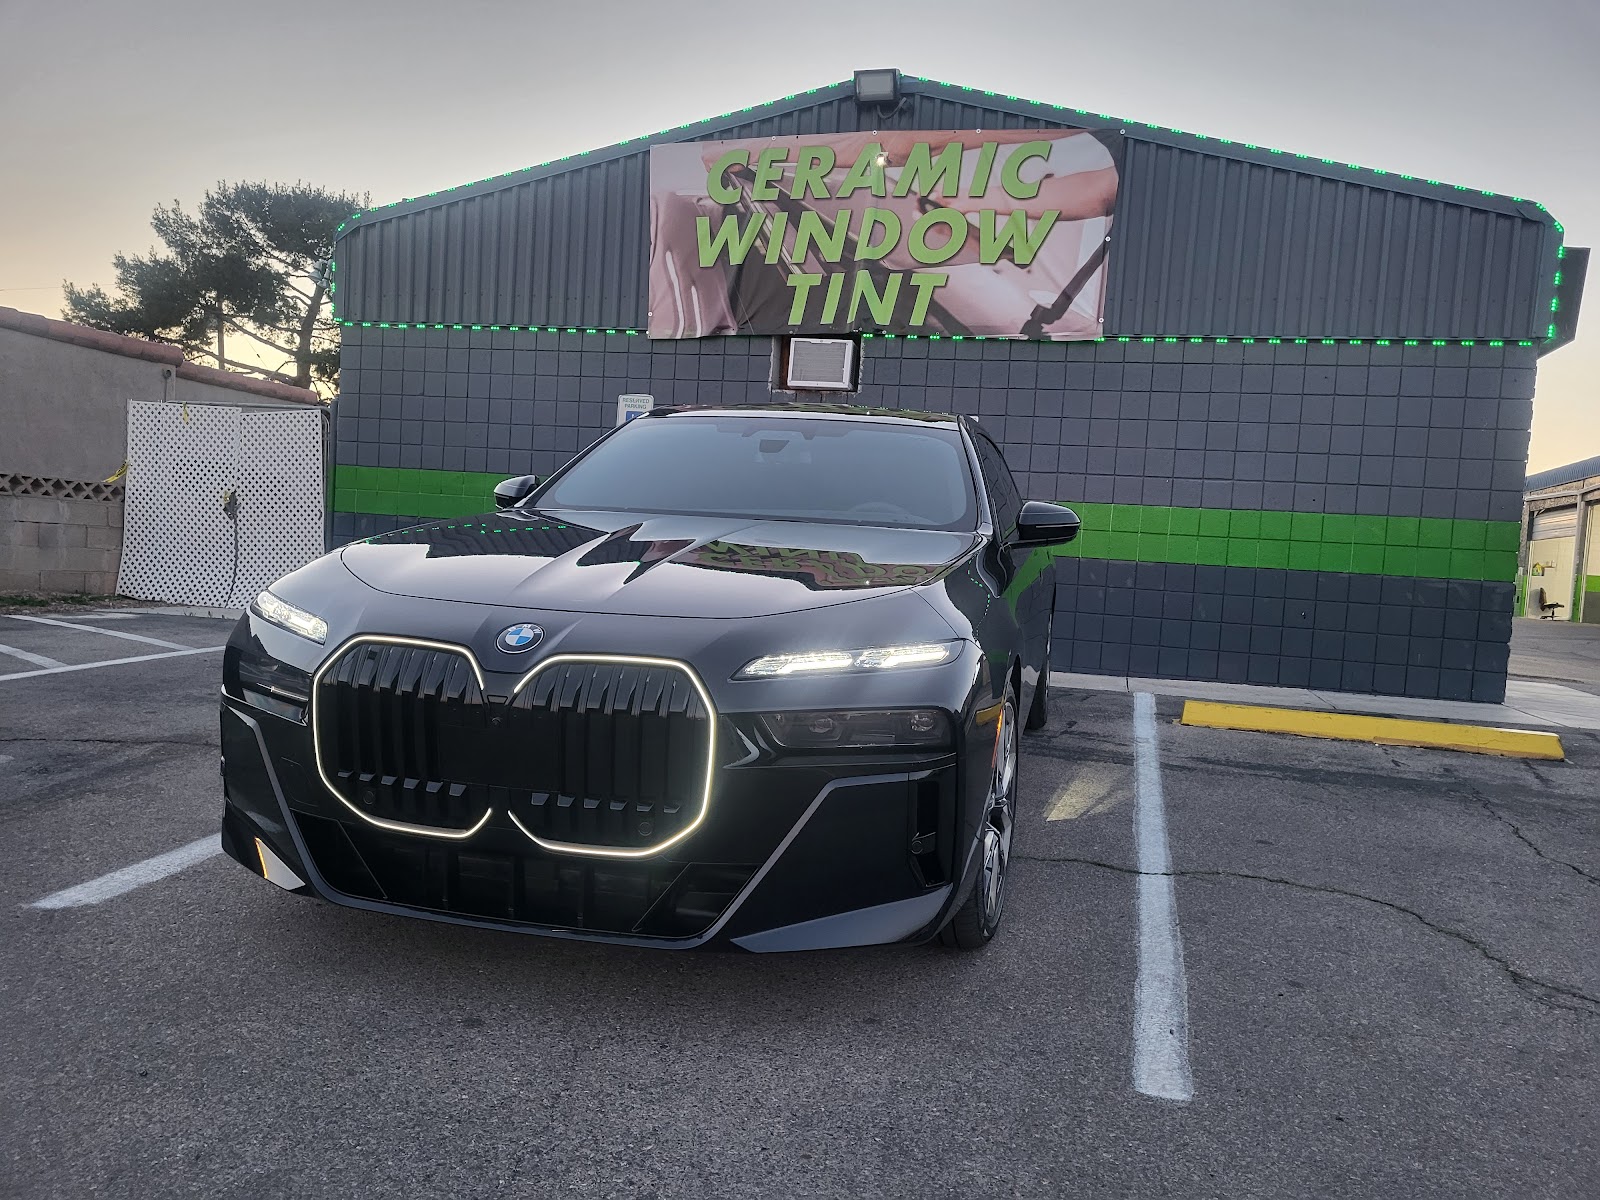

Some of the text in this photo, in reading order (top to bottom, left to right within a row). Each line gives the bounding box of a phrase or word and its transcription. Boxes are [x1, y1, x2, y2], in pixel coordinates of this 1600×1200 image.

[707, 141, 1052, 204] CERAMIC
[695, 208, 1060, 267] WINDOW
[787, 270, 949, 327] TINT
